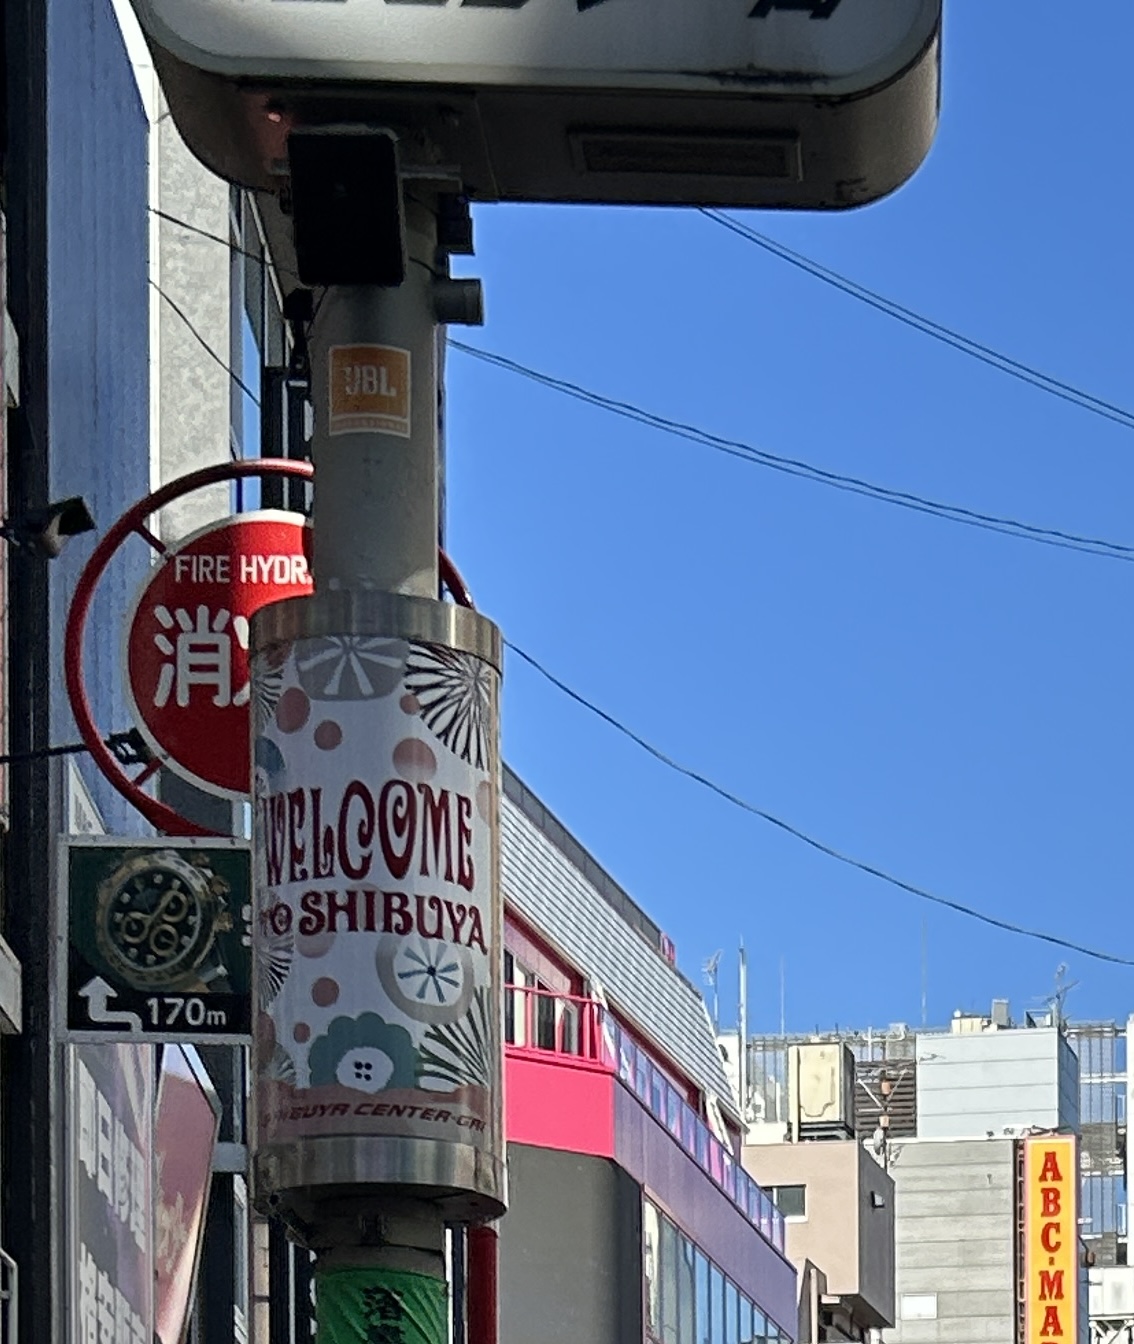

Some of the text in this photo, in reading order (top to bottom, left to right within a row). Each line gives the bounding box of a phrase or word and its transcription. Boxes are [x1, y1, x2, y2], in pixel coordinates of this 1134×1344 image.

[340, 365, 397, 397] JBL
[174, 555, 313, 584] FIRE HYDR
[263, 780, 474, 892] WELCOME
[299, 890, 488, 955] SHIBUYA
[147, 999, 227, 1027] 170m
